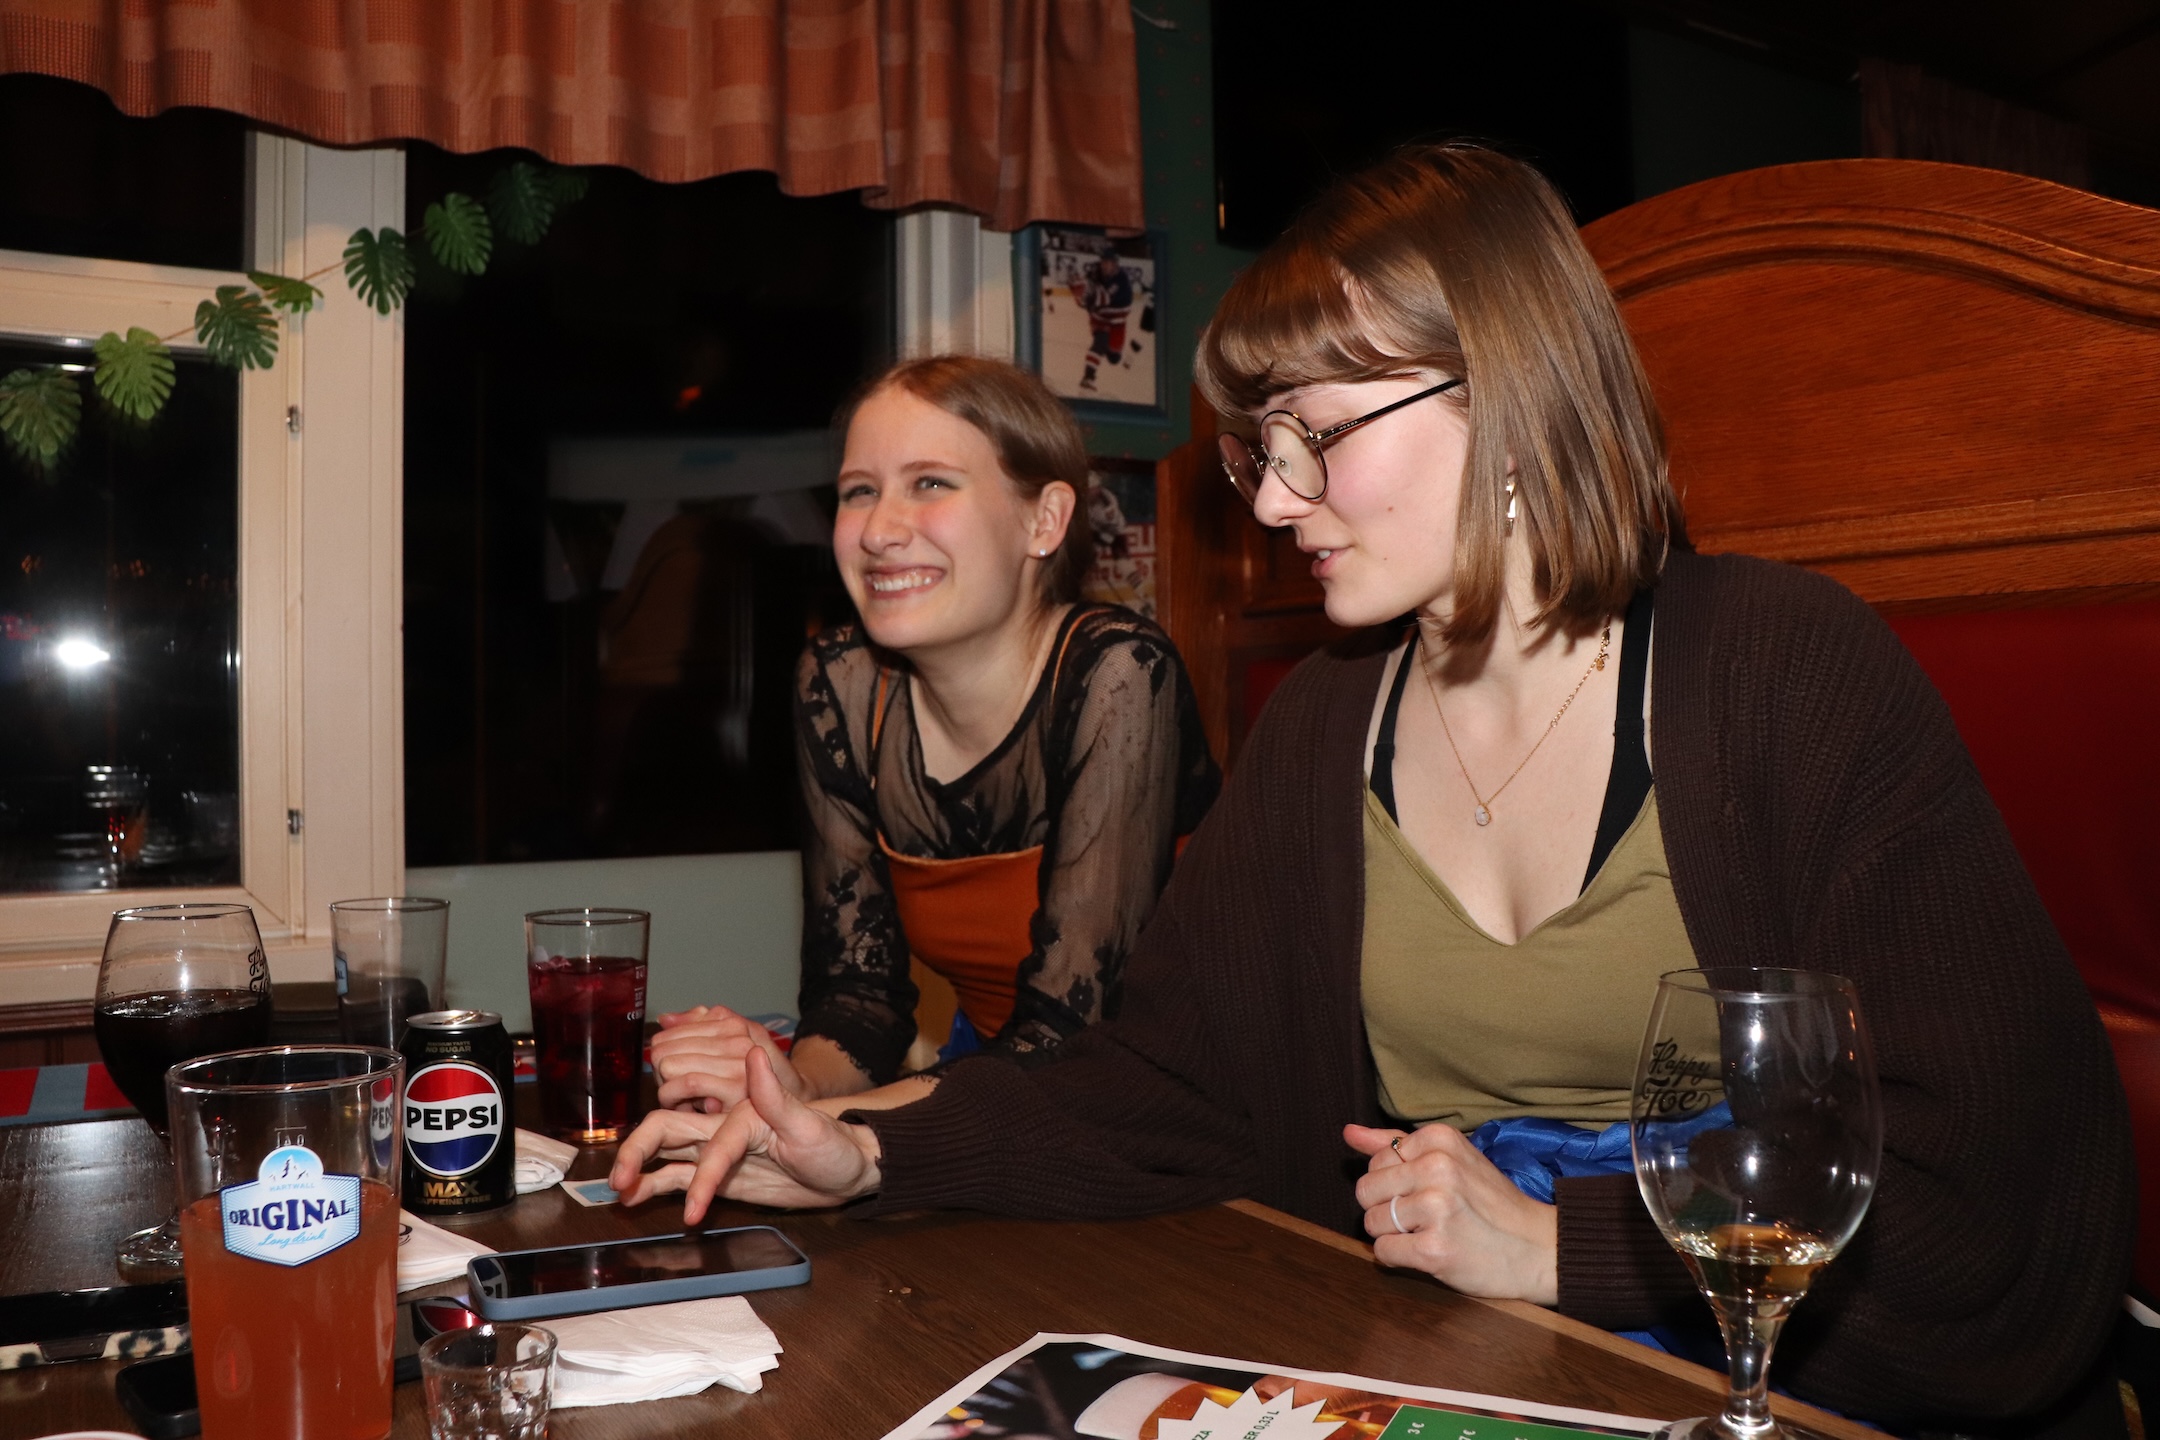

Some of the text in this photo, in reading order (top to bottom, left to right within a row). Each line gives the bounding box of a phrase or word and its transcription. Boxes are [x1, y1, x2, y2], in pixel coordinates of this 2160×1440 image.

[439, 1045, 472, 1053] SUGAR
[1648, 1037, 1711, 1088] Happy
[406, 1103, 498, 1131] PEPSI
[1635, 1076, 1711, 1140] Joe
[269, 1182, 316, 1192] HARTWALL
[422, 1180, 481, 1198] MAX
[464, 1193, 492, 1204] FREE
[229, 1198, 351, 1231] ORIGINAL
[258, 1228, 328, 1249] Long drink
[1253, 1416, 1274, 1430] 0,33
[1407, 1422, 1425, 1435] 3€
